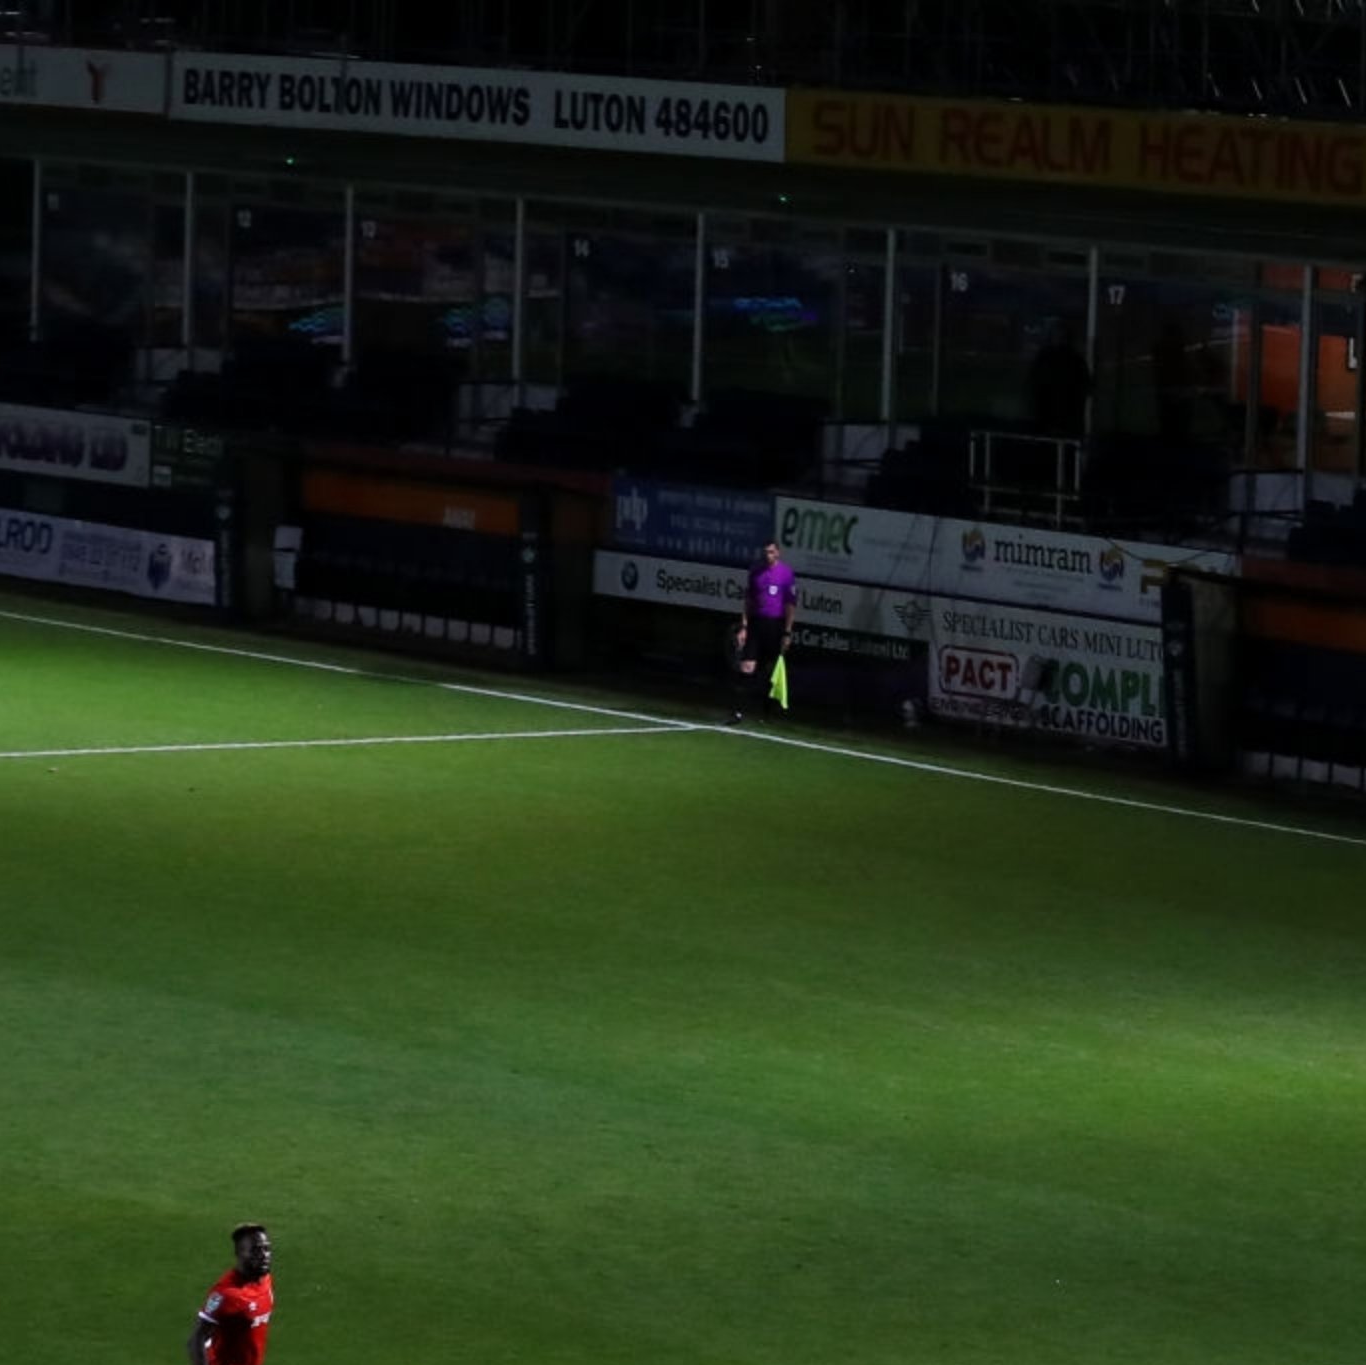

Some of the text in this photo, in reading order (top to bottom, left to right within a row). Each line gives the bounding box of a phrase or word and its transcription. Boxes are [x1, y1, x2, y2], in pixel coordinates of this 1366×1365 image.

[184, 69, 769, 143] BARRY BOLTON WINDOWS LUTON 484600
[813, 101, 1364, 195] SUN REALM HEATING
[1108, 284, 1126, 305] 17
[780, 507, 858, 555] emec
[993, 533, 1094, 575] mimram
[655, 570, 723, 598] Specialist
[802, 593, 842, 615] Luton
[942, 611, 1033, 645] SPECIALIST
[1037, 626, 1078, 650] CARS
[1084, 633, 1120, 657] MINI
[944, 655, 1013, 692] PACT
[1040, 704, 1164, 743] SCAFFOLDING
